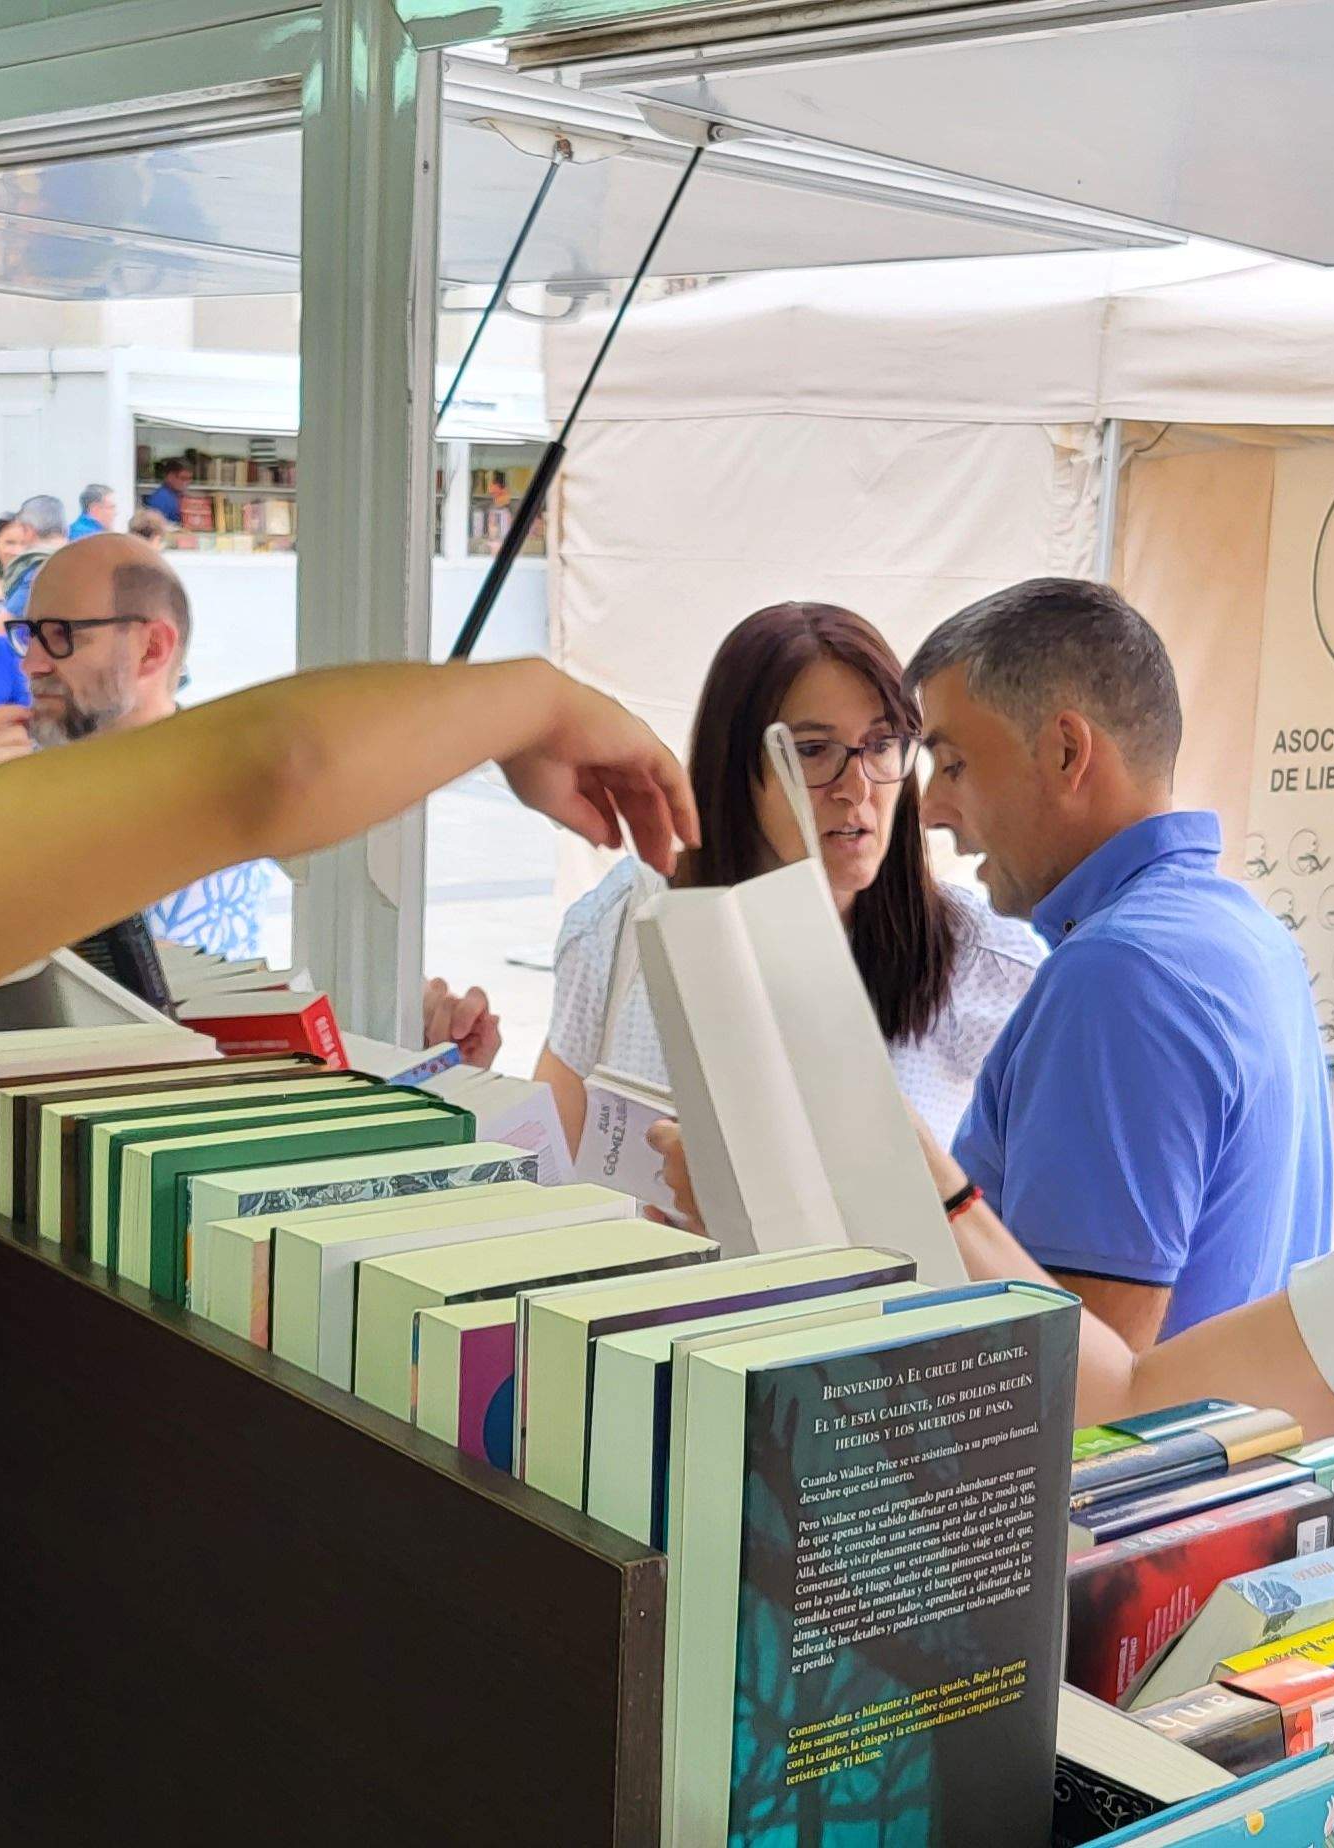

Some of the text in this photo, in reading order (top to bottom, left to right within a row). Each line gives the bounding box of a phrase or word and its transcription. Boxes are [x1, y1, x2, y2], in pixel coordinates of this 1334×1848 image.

[1270, 767, 1298, 792] DE
[813, 1374, 1032, 1435] EL TÉ ESTÁ CALIENTE, LOS BOLLOS RECIÉN
[822, 1376, 893, 1401] BIENVENIDO
[906, 1366, 922, 1383] EL
[924, 1362, 957, 1379] CRUCE
[960, 1358, 974, 1371] DE
[976, 1347, 1028, 1368] CARONTE.
[799, 1471, 838, 1490] Cuando
[838, 1464, 874, 1481] Wallace
[875, 1458, 899, 1471] Price
[898, 1455, 909, 1466] se
[909, 1453, 921, 1463] ve
[920, 1441, 964, 1460] asistiendo
[970, 1438, 981, 1448] su
[981, 1430, 1009, 1448] propio
[1008, 1422, 1039, 1439] funeral,
[834, 1430, 880, 1451] HECHOS
[894, 1422, 915, 1437] LOS
[916, 1410, 966, 1432] MUERTOS
[968, 1407, 982, 1420] DE
[984, 1400, 1013, 1416] PASO.
[796, 1481, 1035, 1549] do que apenas ha sabido disfrutar en vida. De modo que,
[797, 1465, 1036, 1534] Pero Wallace no está preparado para abandonar este mun-
[798, 1470, 914, 1506] descubre que está muerto.
[793, 1539, 1032, 1612] con la ayuda de Hugo, dueño de una pintoresca tetería es-
[794, 1524, 1033, 1597] Comenzará entonces un extraordinario viaje en el que,
[795, 1510, 1034, 1581] Allá, decide vivir plenamente esos siete días que le quedan.
[790, 1652, 834, 1674] se perdió.
